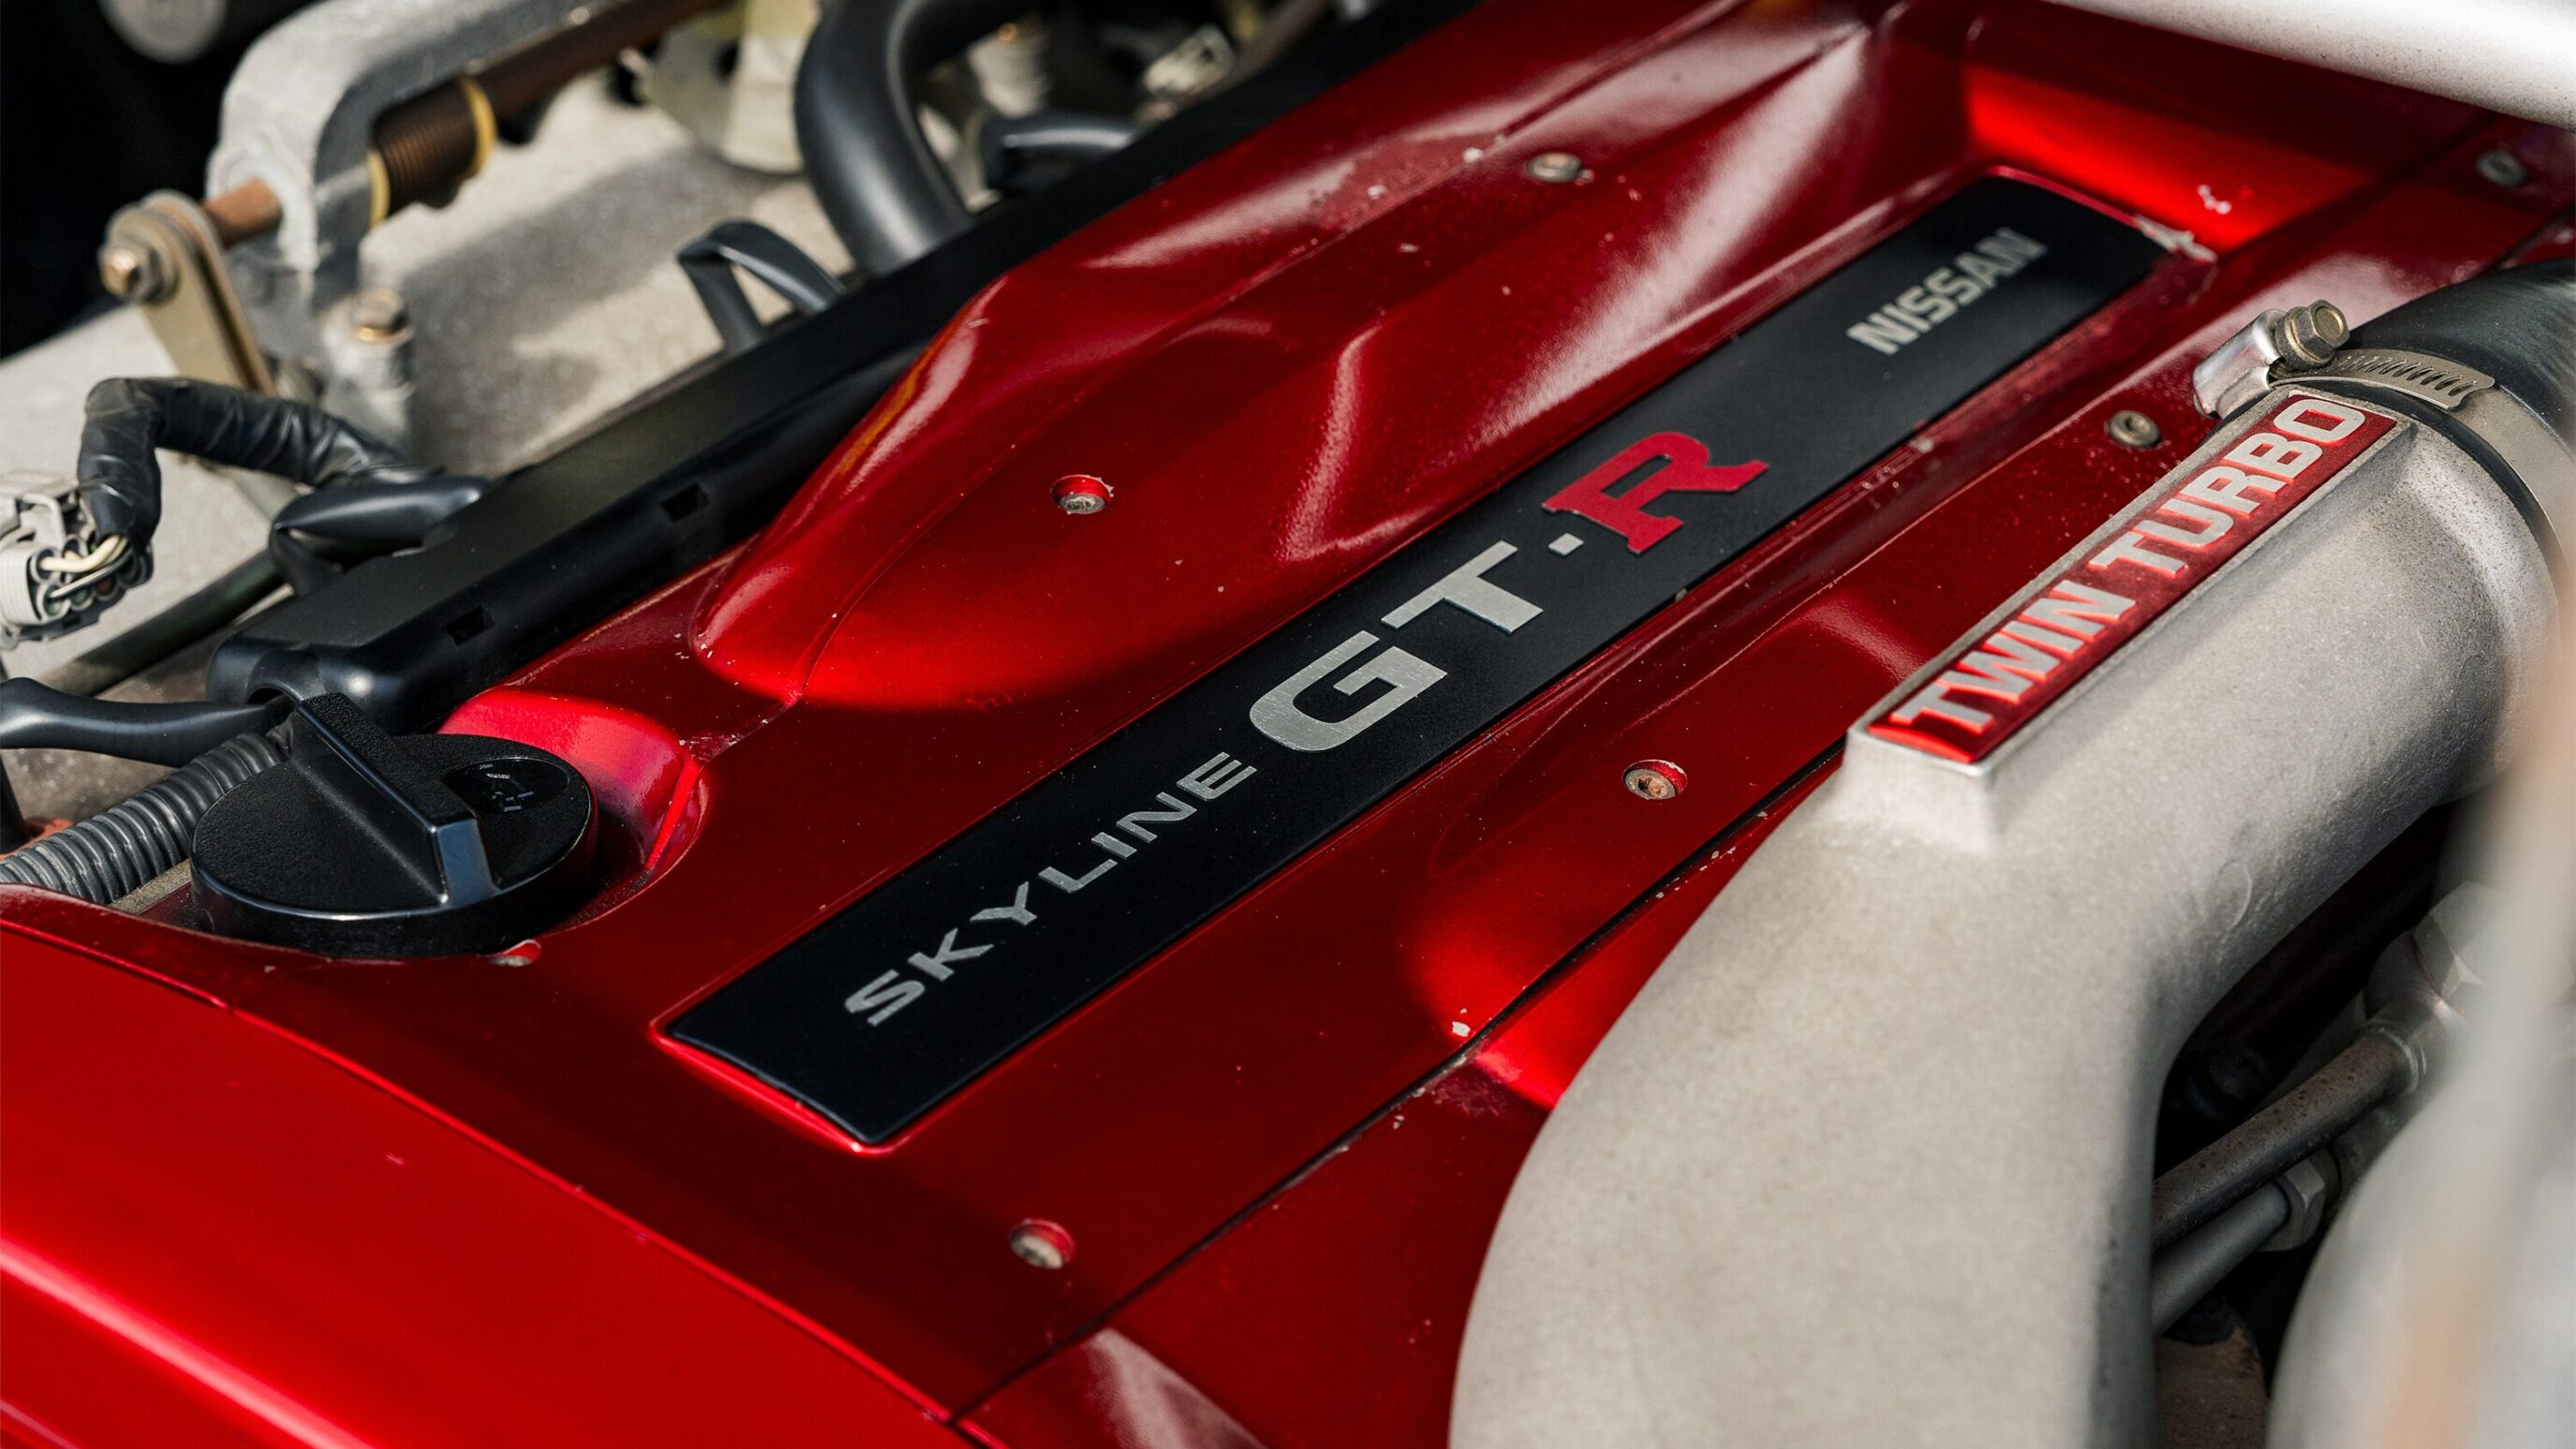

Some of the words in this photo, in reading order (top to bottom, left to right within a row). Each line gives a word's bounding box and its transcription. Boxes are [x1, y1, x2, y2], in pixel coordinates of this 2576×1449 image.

[1848, 229, 2047, 355] NISSAN
[1890, 581, 2137, 732] TWIN
[2089, 398, 2367, 578] TURBO
[845, 752, 1256, 1025] SKYLINE
